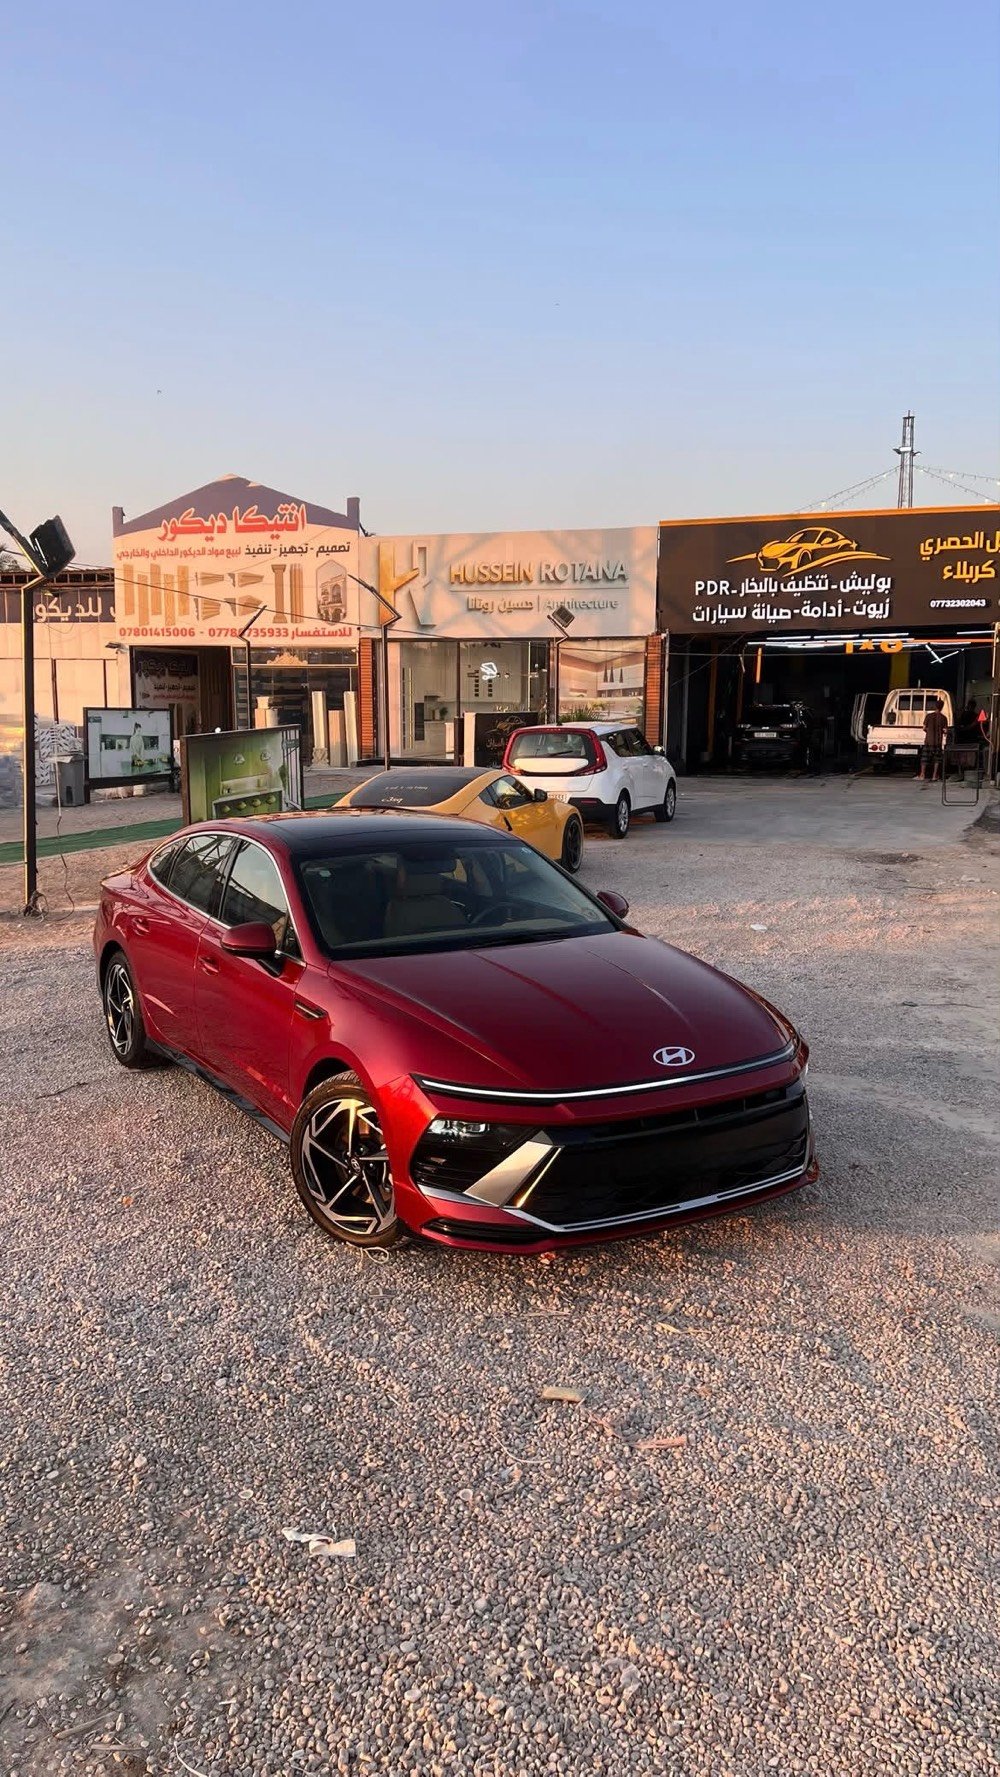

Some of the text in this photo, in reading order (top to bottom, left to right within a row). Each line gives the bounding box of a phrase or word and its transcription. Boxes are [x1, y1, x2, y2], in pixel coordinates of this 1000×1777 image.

[158, 507, 227, 542] ديكور
[245, 544, 272, 558] تنفيذ
[279, 544, 308, 557] تجهيز
[316, 542, 350, 557] تصميم
[920, 531, 984, 560] الحصري
[450, 560, 628, 584] HUSSEIN ROTANA
[943, 560, 996, 583] كربلاء
[695, 580, 730, 596] PDR
[740, 577, 778, 598] بالبخار
[780, 574, 829, 597] تنظيف
[840, 570, 892, 595] بوليش
[33, 597, 102, 622] للديكو
[498, 597, 534, 614] حسين
[751, 603, 792, 624] صيانة
[801, 599, 842, 618] أدامة
[853, 597, 890, 619] زيوت
[930, 599, 987, 608] 07732302043
[692, 604, 747, 624] سيارات
[119, 627, 195, 637] 07801415006
[291, 627, 352, 640] للاستفسار
